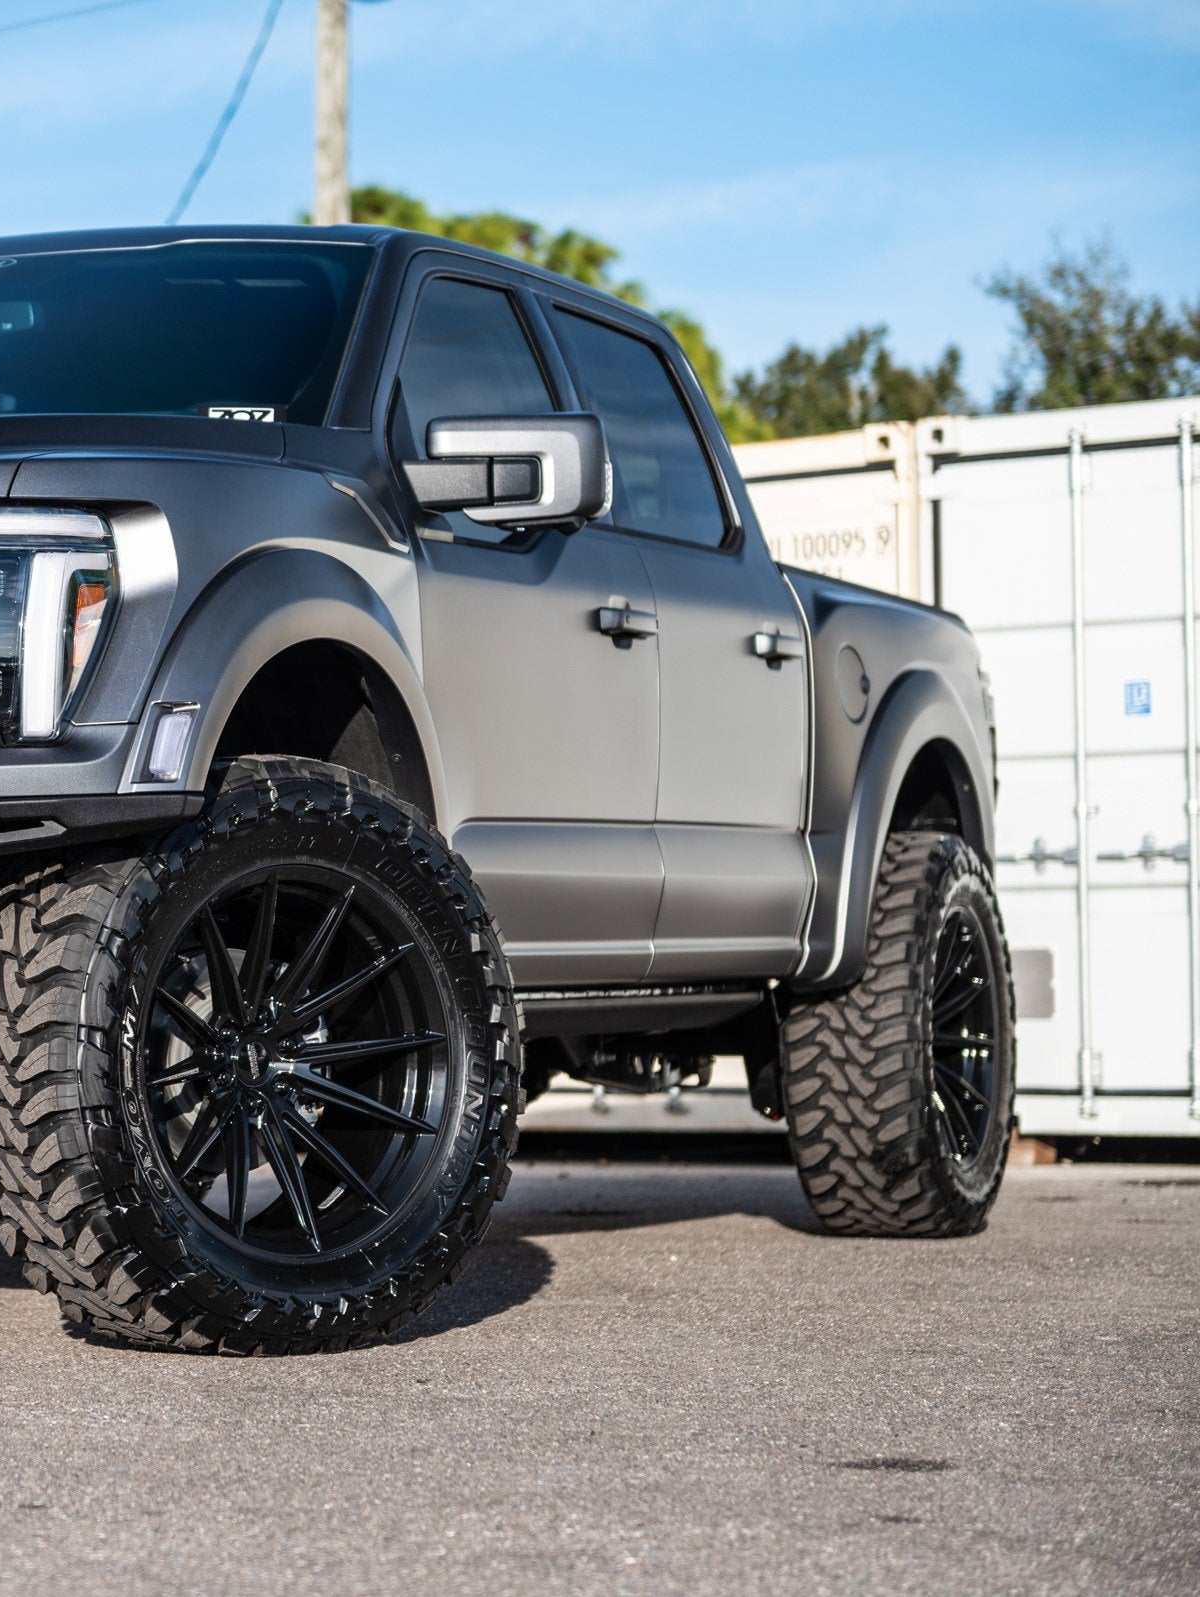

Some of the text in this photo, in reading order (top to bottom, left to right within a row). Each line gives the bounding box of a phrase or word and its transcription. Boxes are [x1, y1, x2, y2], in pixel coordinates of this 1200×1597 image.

[792, 529, 866, 560] 100095
[876, 524, 891, 555] 9
[376, 856, 464, 959] OPEN
[434, 976, 488, 1216] COUNTRY
[123, 1087, 194, 1235] TOYO
